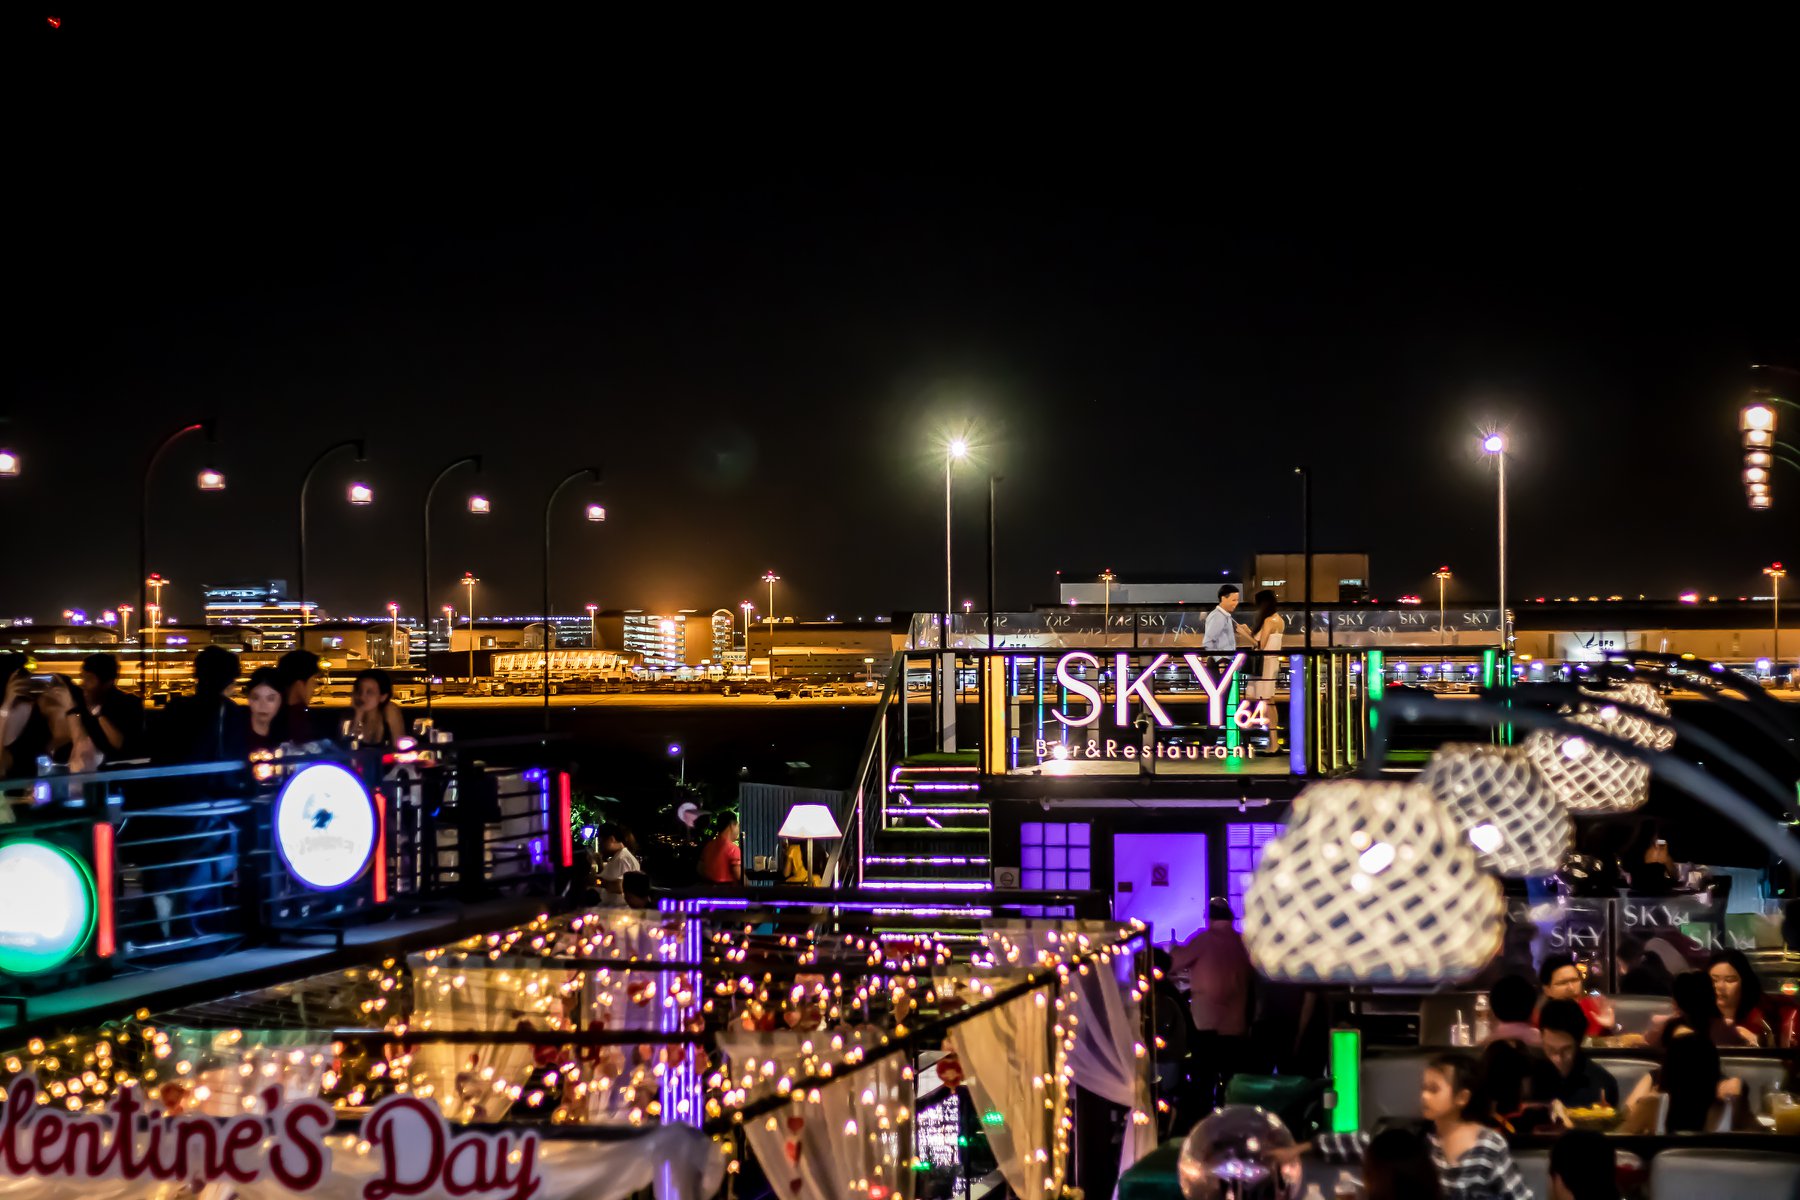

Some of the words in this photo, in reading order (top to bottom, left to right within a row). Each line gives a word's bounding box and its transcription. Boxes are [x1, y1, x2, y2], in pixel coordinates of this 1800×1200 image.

[1141, 615, 1167, 626] SKY
[1338, 614, 1366, 626] SKY
[1400, 613, 1428, 625] SKY
[1463, 612, 1491, 624] SKY
[1052, 652, 1247, 727] SKY
[1234, 700, 1271, 728] 64
[1036, 739, 1255, 759] Br&Restaurant
[1624, 905, 1677, 927] SKY
[1551, 926, 1603, 947] SKY
[363, 1098, 541, 1200] Day
